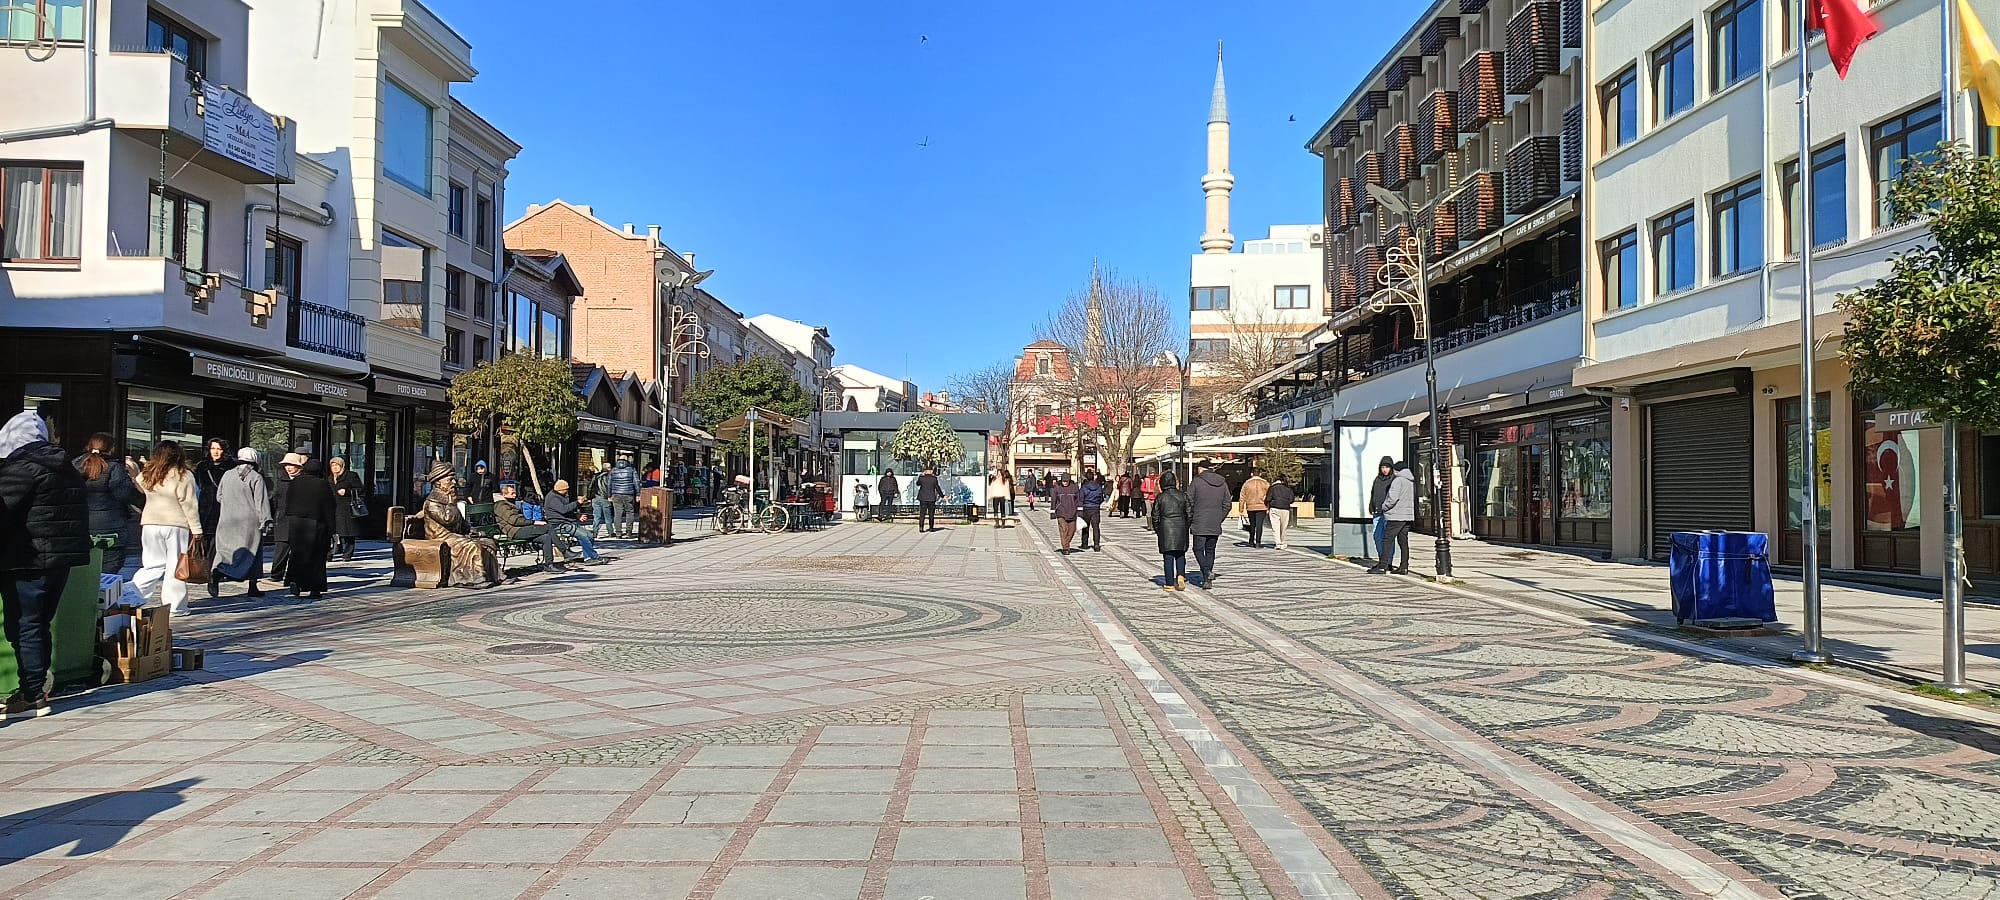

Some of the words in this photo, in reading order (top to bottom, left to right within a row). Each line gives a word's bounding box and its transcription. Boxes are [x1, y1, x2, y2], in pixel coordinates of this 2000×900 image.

[1516, 225, 1527, 236] CAFE
[1532, 214, 1545, 228] SINCE
[207, 363, 255, 381] PEŞİNCİOĞLU
[257, 372, 297, 389] KUYUMCUSU
[313, 382, 348, 397] KEÇECİZADE
[397, 384, 411, 395] FOTO
[411, 387, 427, 397] ENDER
[1890, 412, 1909, 425] PTT
